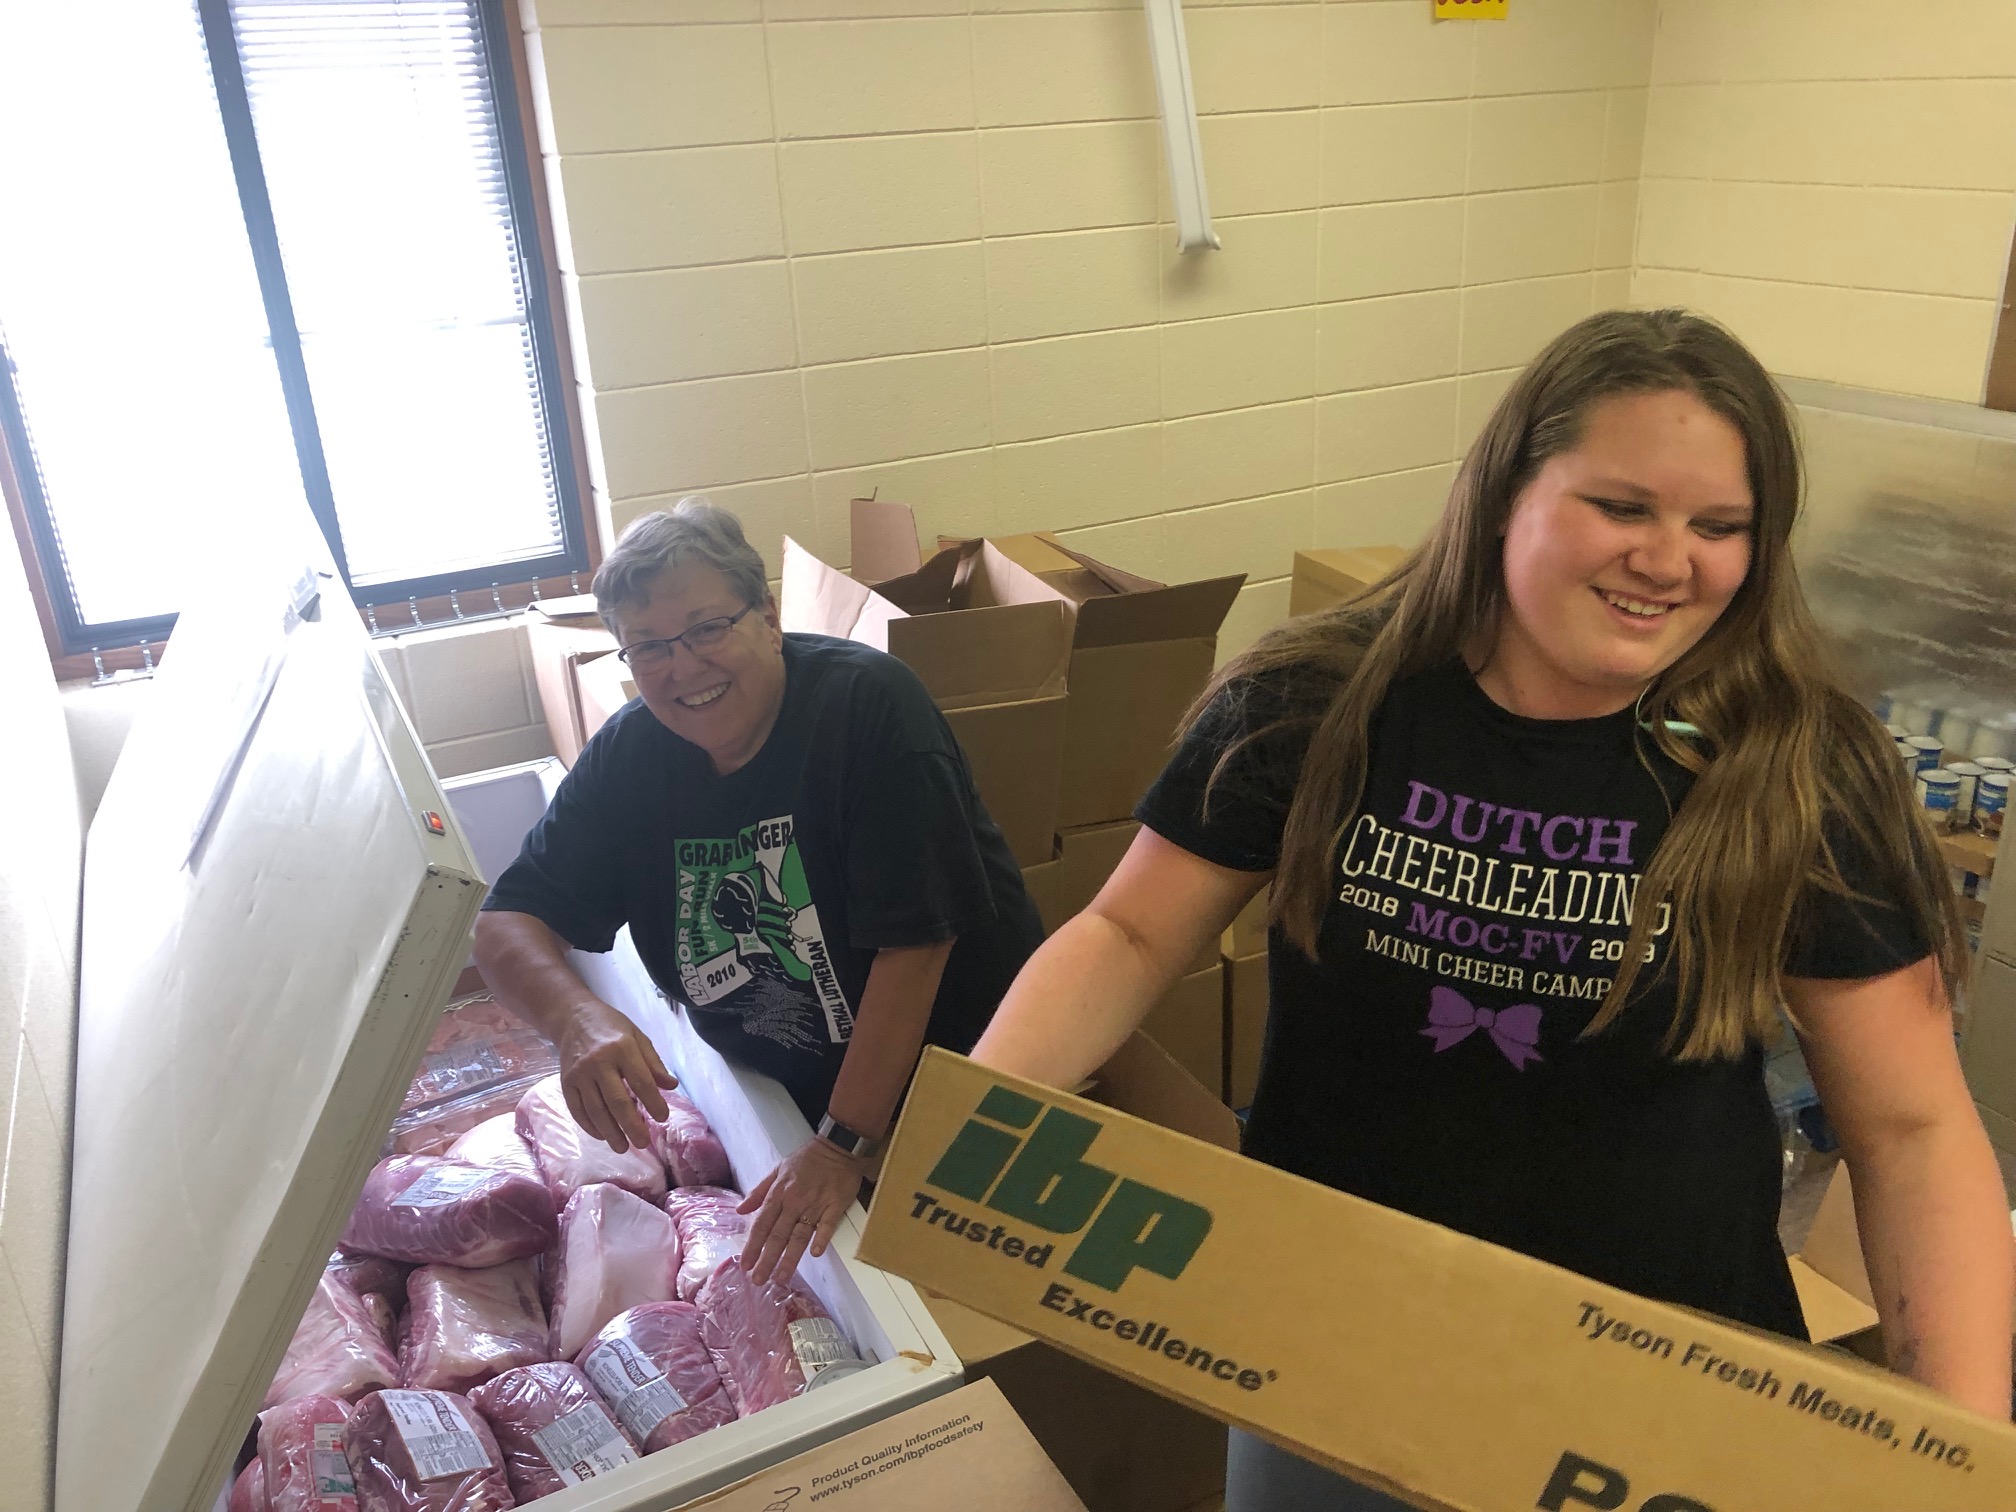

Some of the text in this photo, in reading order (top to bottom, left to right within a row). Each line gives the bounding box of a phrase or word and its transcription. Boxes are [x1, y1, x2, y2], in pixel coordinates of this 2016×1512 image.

[1400, 780, 1638, 865] DUTCH
[678, 869, 710, 1001] LABOR DAY
[691, 920, 708, 957] FUN
[708, 940, 718, 952] 5K
[1339, 883, 1655, 964] 2018 MOC-FV 209
[706, 963, 736, 988] 2010
[807, 940, 842, 1001] LUTHERAN
[1365, 929, 1613, 1001] MINI CHEER CAMP
[925, 1084, 1214, 1293] ibp
[909, 1192, 1056, 1269] Trusted
[610, 1340, 646, 1384] SUPREME TENDER
[1576, 1301, 1976, 1474] Tyson Fresh Meats, Inc.
[810, 1421, 984, 1502] www.tyson.com/ibpfoodsafety
[811, 1414, 971, 1488] Product Quality Information
